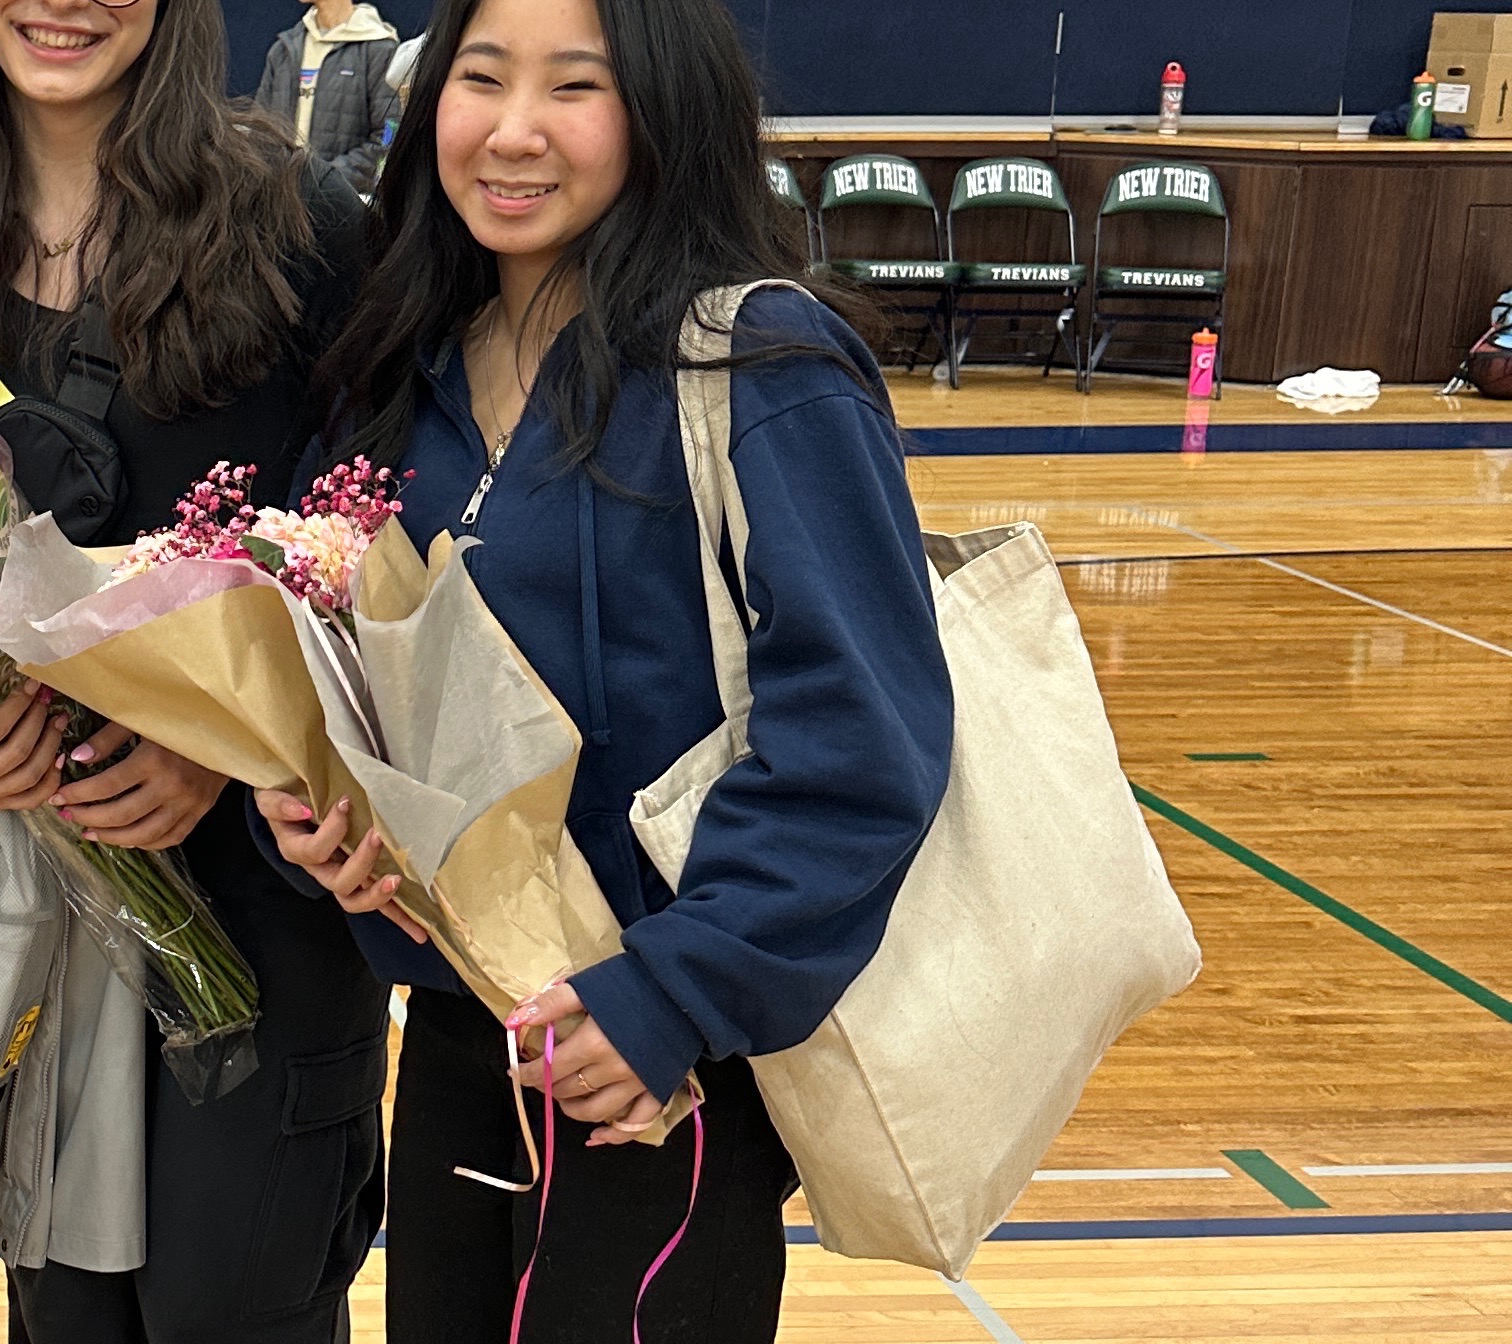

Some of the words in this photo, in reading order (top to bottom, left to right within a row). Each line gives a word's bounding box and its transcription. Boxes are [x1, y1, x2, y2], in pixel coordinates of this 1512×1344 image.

[832, 162, 870, 197] NEW
[873, 161, 918, 196] TRIER
[965, 164, 1004, 199] NEW
[1007, 164, 1053, 199] TRIER
[1118, 167, 1160, 202] NEW
[1163, 167, 1210, 203] TRIER
[870, 265, 945, 278] TREVIANS
[991, 267, 1070, 281] TREVIANS
[1121, 271, 1205, 287] TREVIANS
